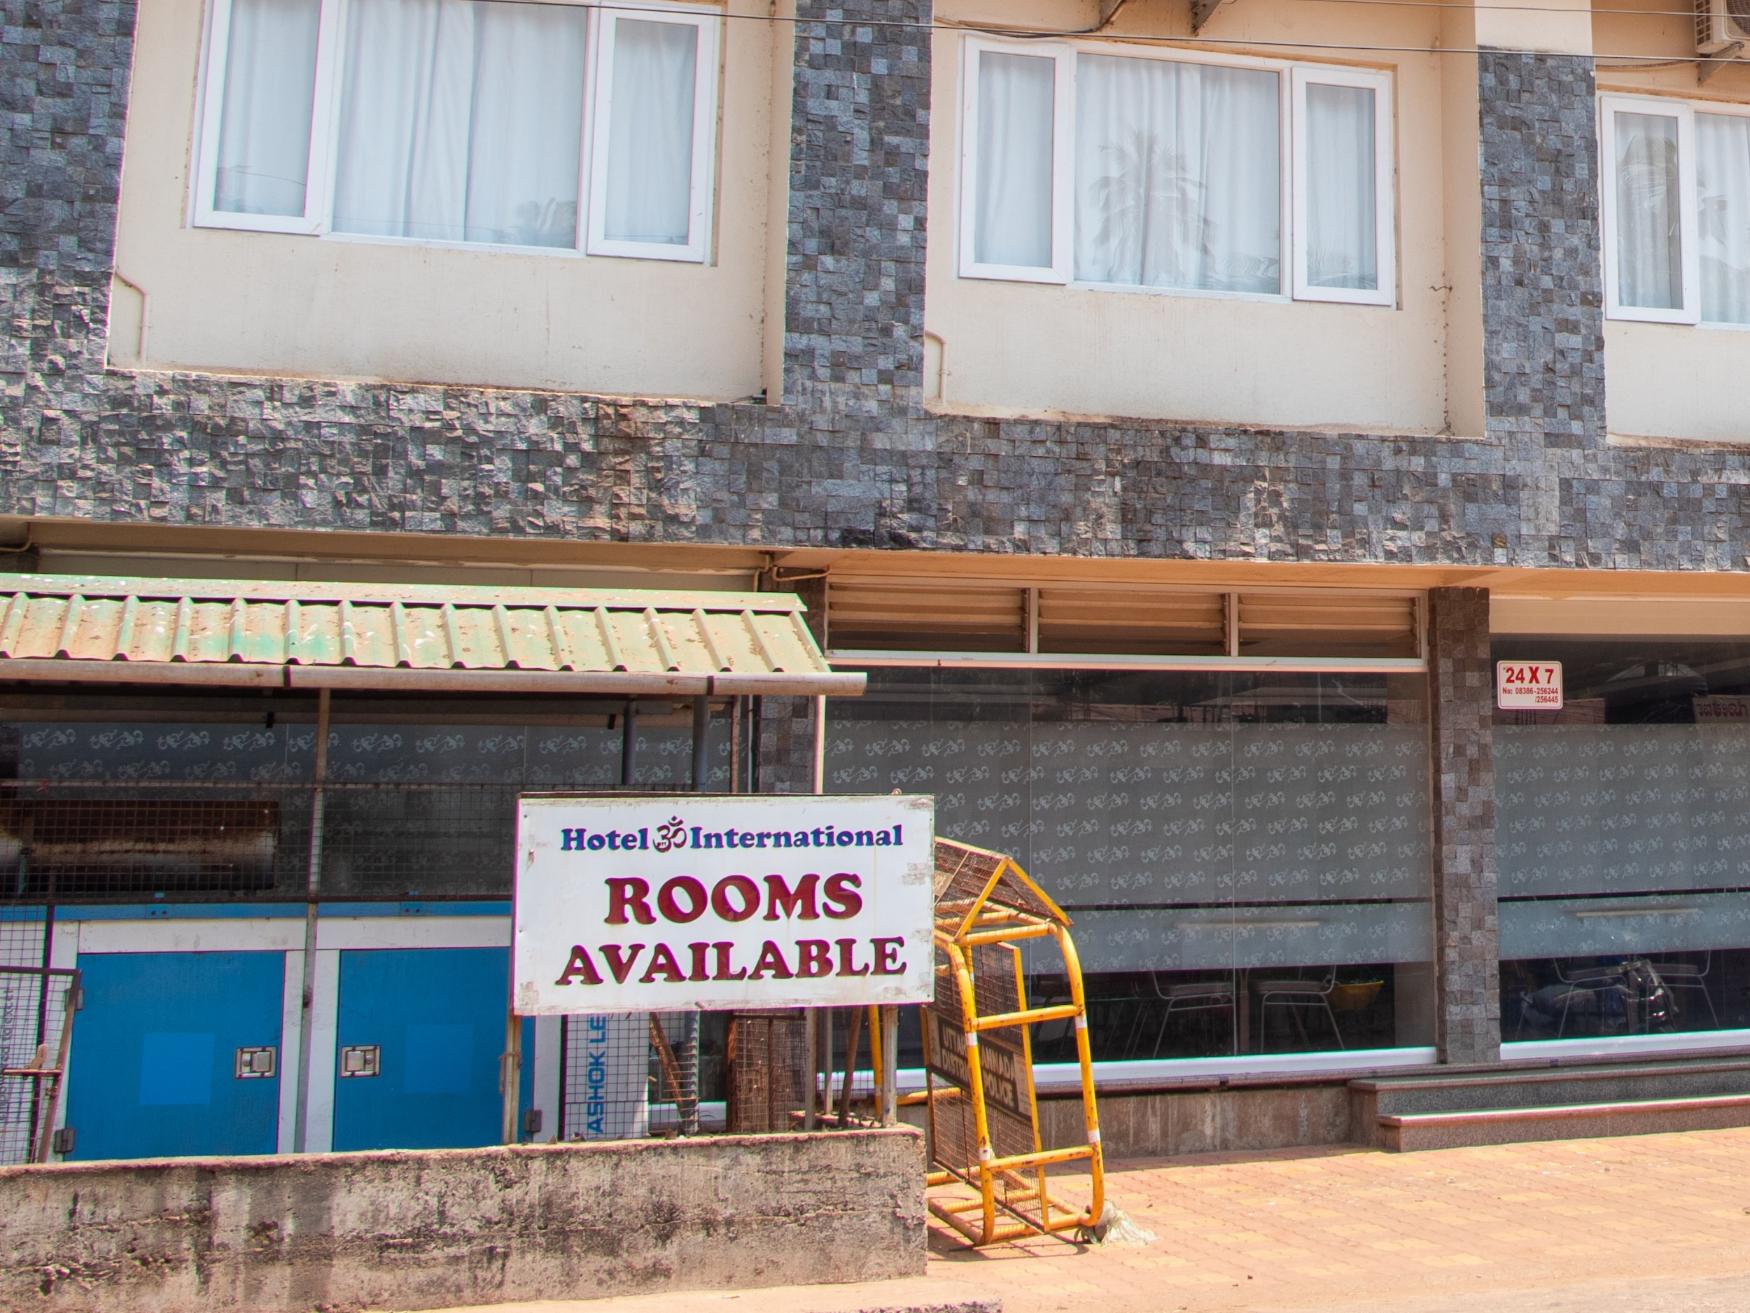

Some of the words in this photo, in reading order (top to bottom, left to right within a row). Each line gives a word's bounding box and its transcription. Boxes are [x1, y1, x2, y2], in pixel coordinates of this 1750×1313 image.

[1505, 666, 1525, 684] 24
[1545, 668, 1554, 684] 7
[560, 826, 649, 852] Hotel
[690, 824, 904, 850] International
[603, 872, 864, 925] ROOMS
[555, 936, 908, 986] AVAILABLE
[587, 1050, 606, 1135] ASHOK
